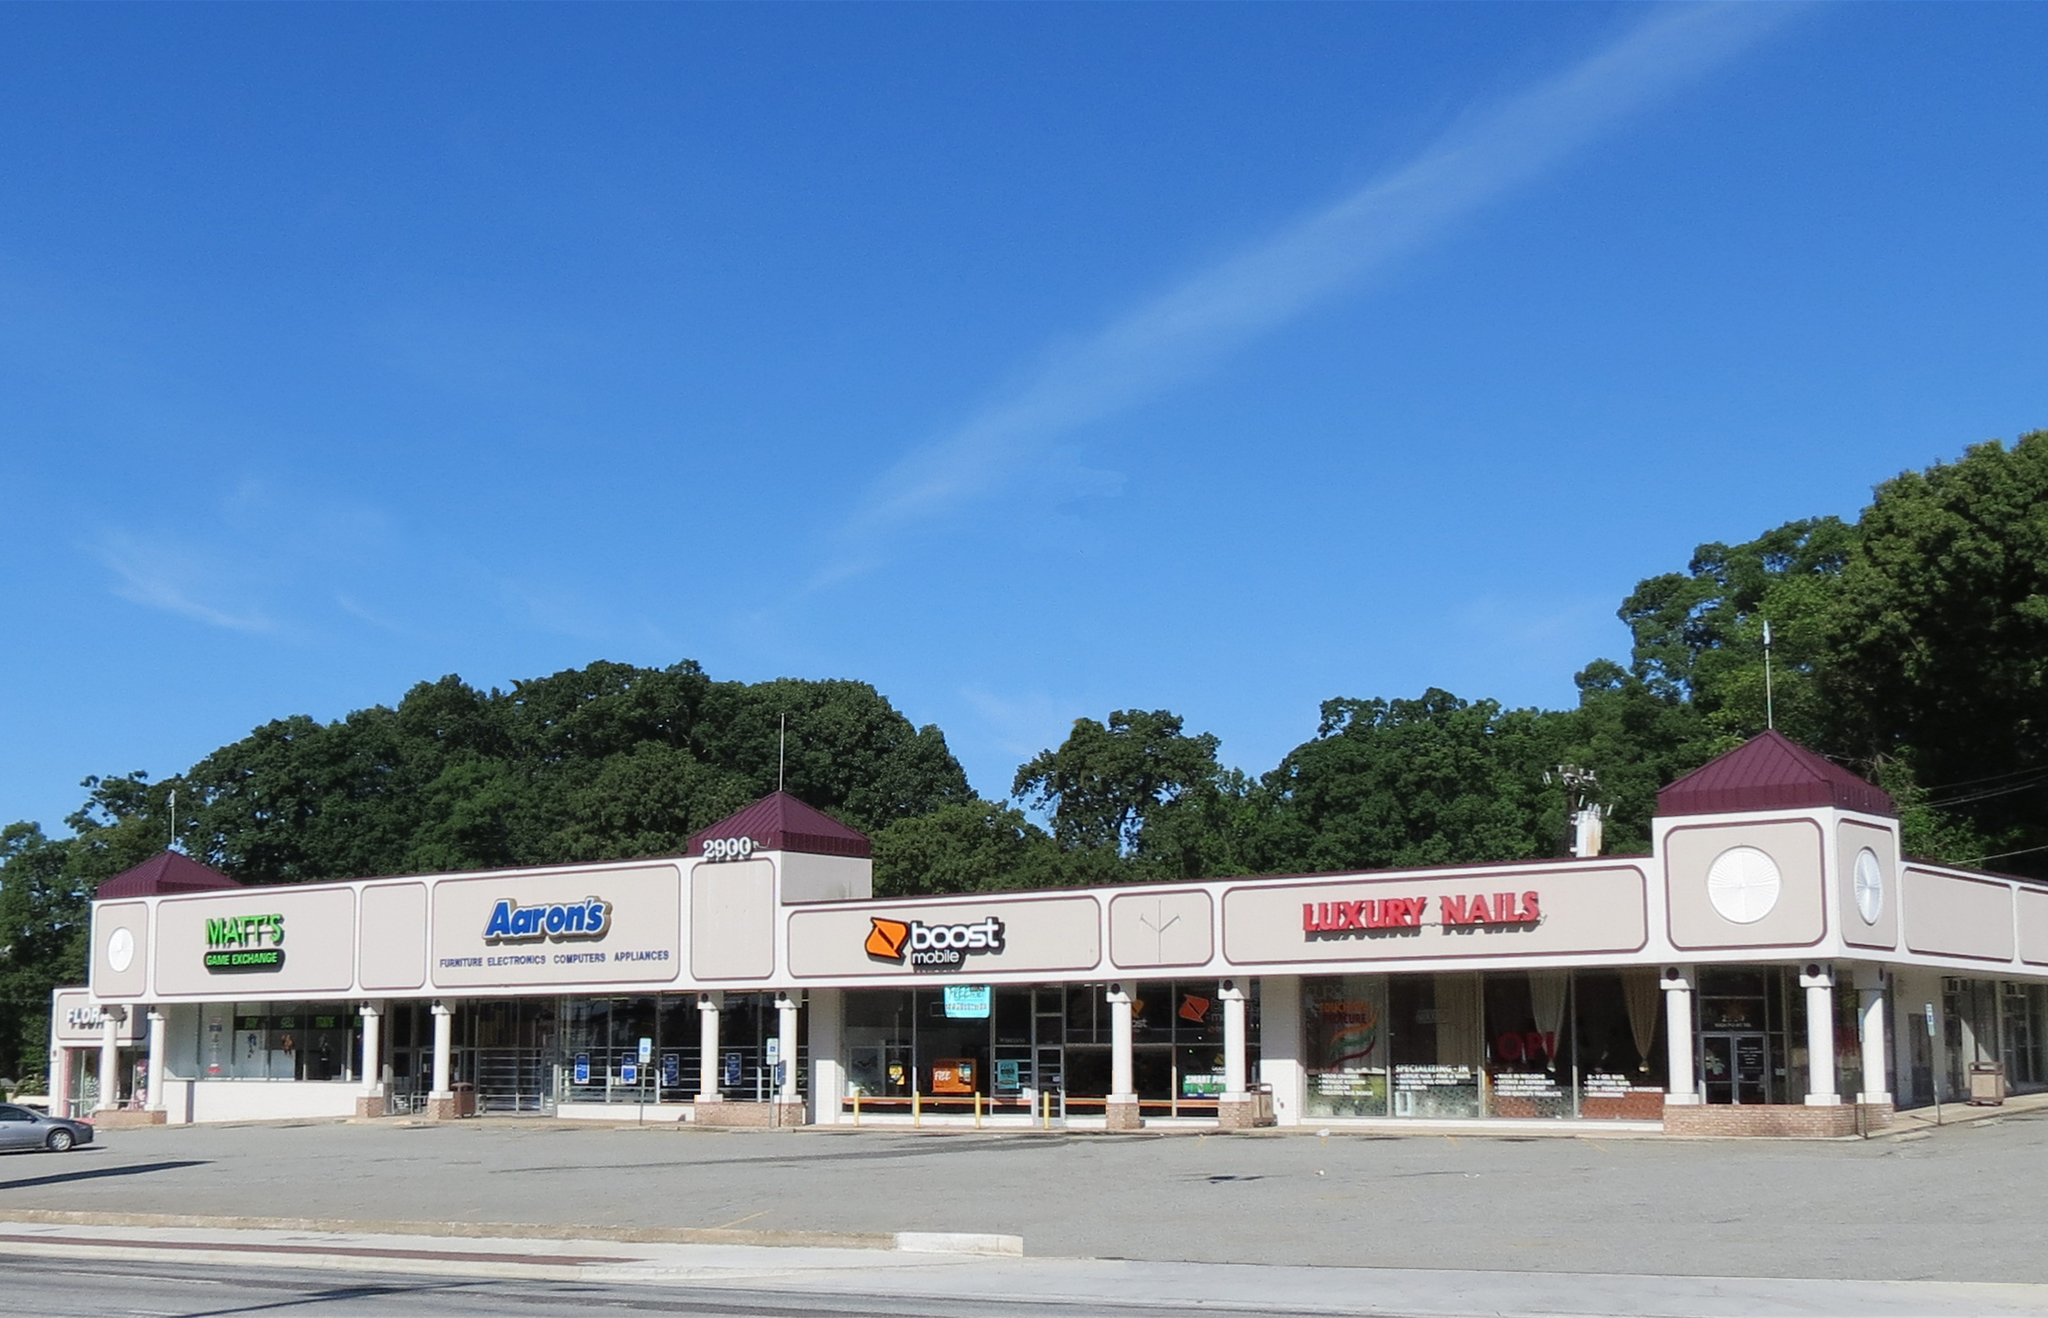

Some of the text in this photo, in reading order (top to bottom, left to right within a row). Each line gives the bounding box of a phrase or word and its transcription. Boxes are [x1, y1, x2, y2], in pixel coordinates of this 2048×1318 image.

[703, 836, 752, 858] 2900
[484, 898, 605, 937] Aaron's
[1303, 891, 1540, 932] LUXURY NAILS
[206, 914, 281, 945] MATT'S
[911, 917, 999, 950] boost
[206, 952, 278, 966] GAME EXCHANGE
[440, 949, 669, 968] FURNITURE ELECTRONICS COMPUTERS APPLIANCES
[912, 950, 960, 965] mobile
